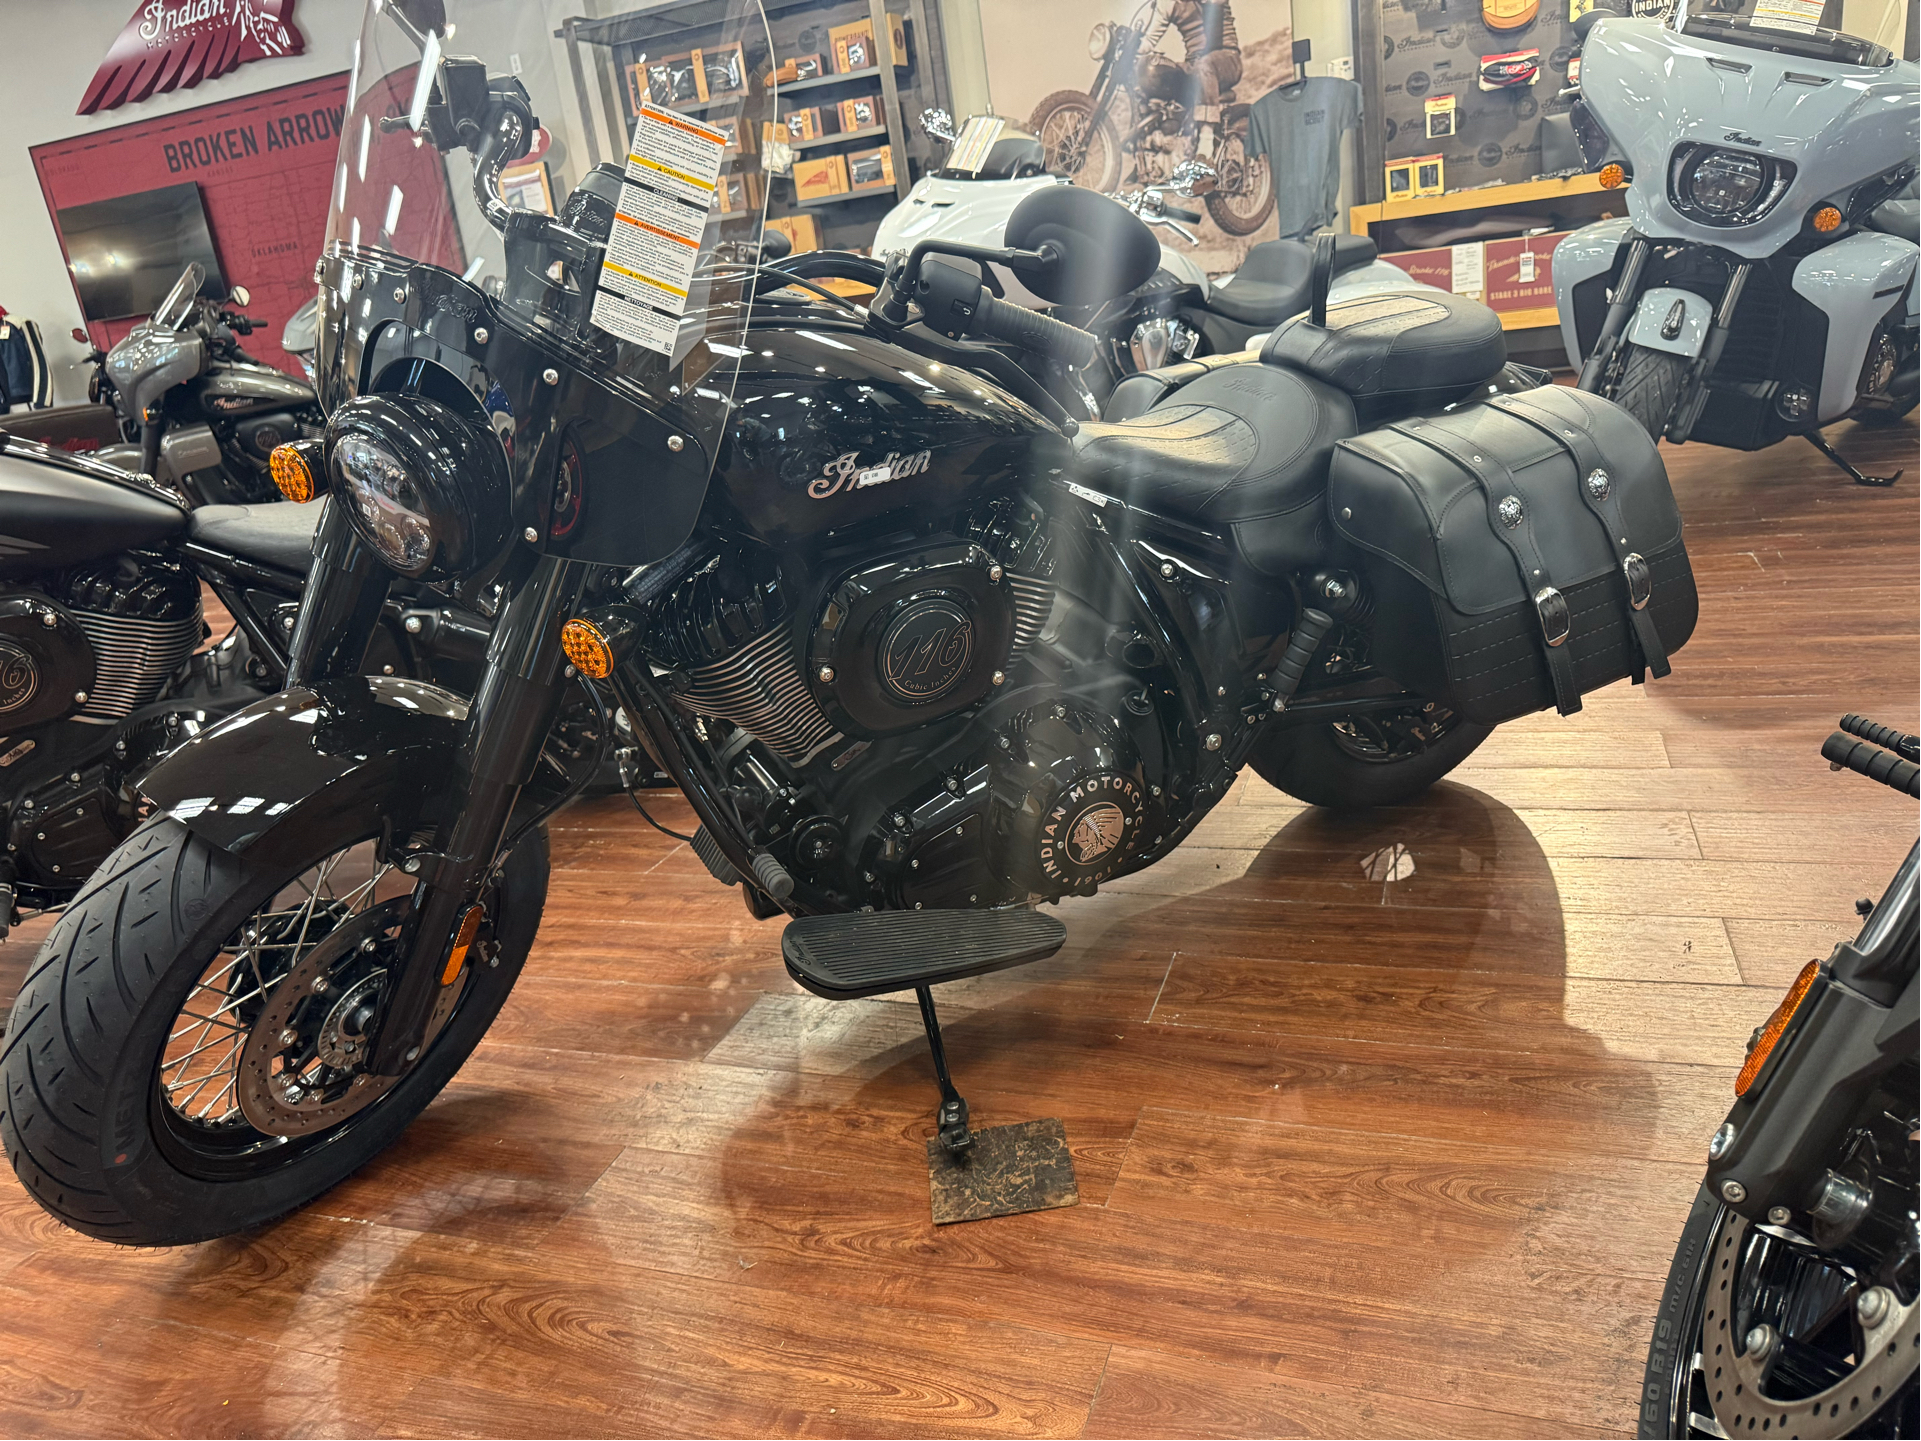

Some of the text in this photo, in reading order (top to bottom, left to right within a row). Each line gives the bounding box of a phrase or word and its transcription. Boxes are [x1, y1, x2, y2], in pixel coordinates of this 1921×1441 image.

[1635, 0, 1671, 12] INDIAN
[139, 0, 225, 39] Indian
[146, 16, 230, 50] MOTORCYCLE
[674, 120, 699, 134] WARNING
[163, 125, 260, 173] BROKEN
[266, 104, 347, 152] ARROW
[1724, 132, 1762, 147] Indian
[662, 167, 685, 180] CAUTION
[652, 187, 678, 202] CLEANING
[640, 221, 680, 242] AVERTISSEMENT
[251, 241, 299, 258] OKLAHOMA
[634, 272, 662, 288] ATTENTION
[623, 294, 653, 311] NETTOYAGE
[211, 396, 254, 411] Indian
[807, 449, 932, 499] Indian
[889, 620, 972, 681] 116
[904, 667, 956, 690] Cubic Inches
[1041, 776, 1144, 879] INDIAN MOTORCYCLE
[1074, 866, 1112, 887] 1901
[1650, 1318, 1673, 1374] B19
[1682, 1238, 1697, 1269] 61H
